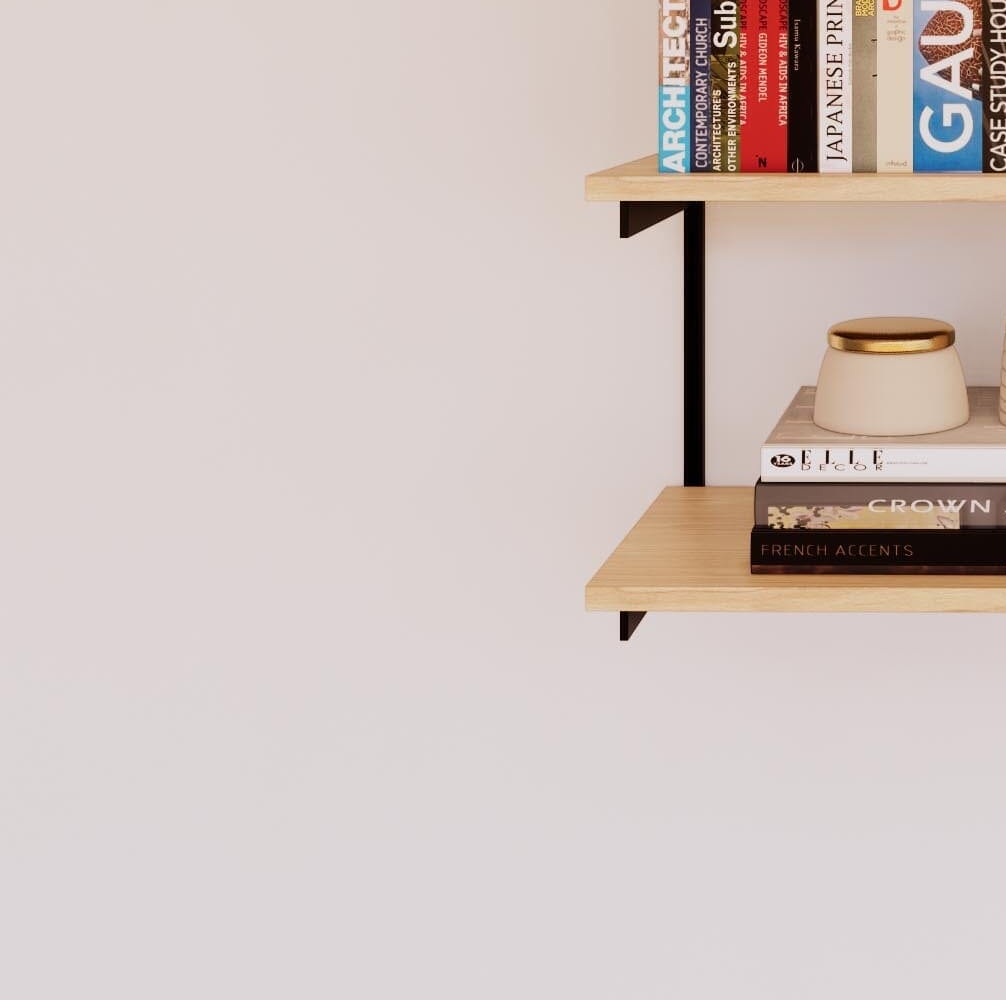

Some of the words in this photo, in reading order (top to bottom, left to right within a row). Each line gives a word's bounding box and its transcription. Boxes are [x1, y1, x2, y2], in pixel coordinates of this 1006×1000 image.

[695, 18, 708, 66] CHURCH
[758, 32, 768, 66] GIDEON
[778, 32, 787, 48] HIV
[778, 60, 787, 81] AIDS
[740, 82, 747, 93] IN
[758, 67, 768, 103] MENDEL
[778, 82, 787, 93] IN
[728, 62, 736, 136] ENVIRONMENTS
[778, 94, 787, 126] AFRICA
[826, 53, 848, 162] JAPANESE
[695, 70, 708, 168] CONTEMPORARY
[728, 139, 736, 171] OTHER
[801, 450, 884, 464] ELLE
[801, 463, 884, 471] DECOR
[868, 499, 991, 514] CROWN
[761, 544, 828, 556] FRENCH
[835, 544, 914, 557] ACCENTS
